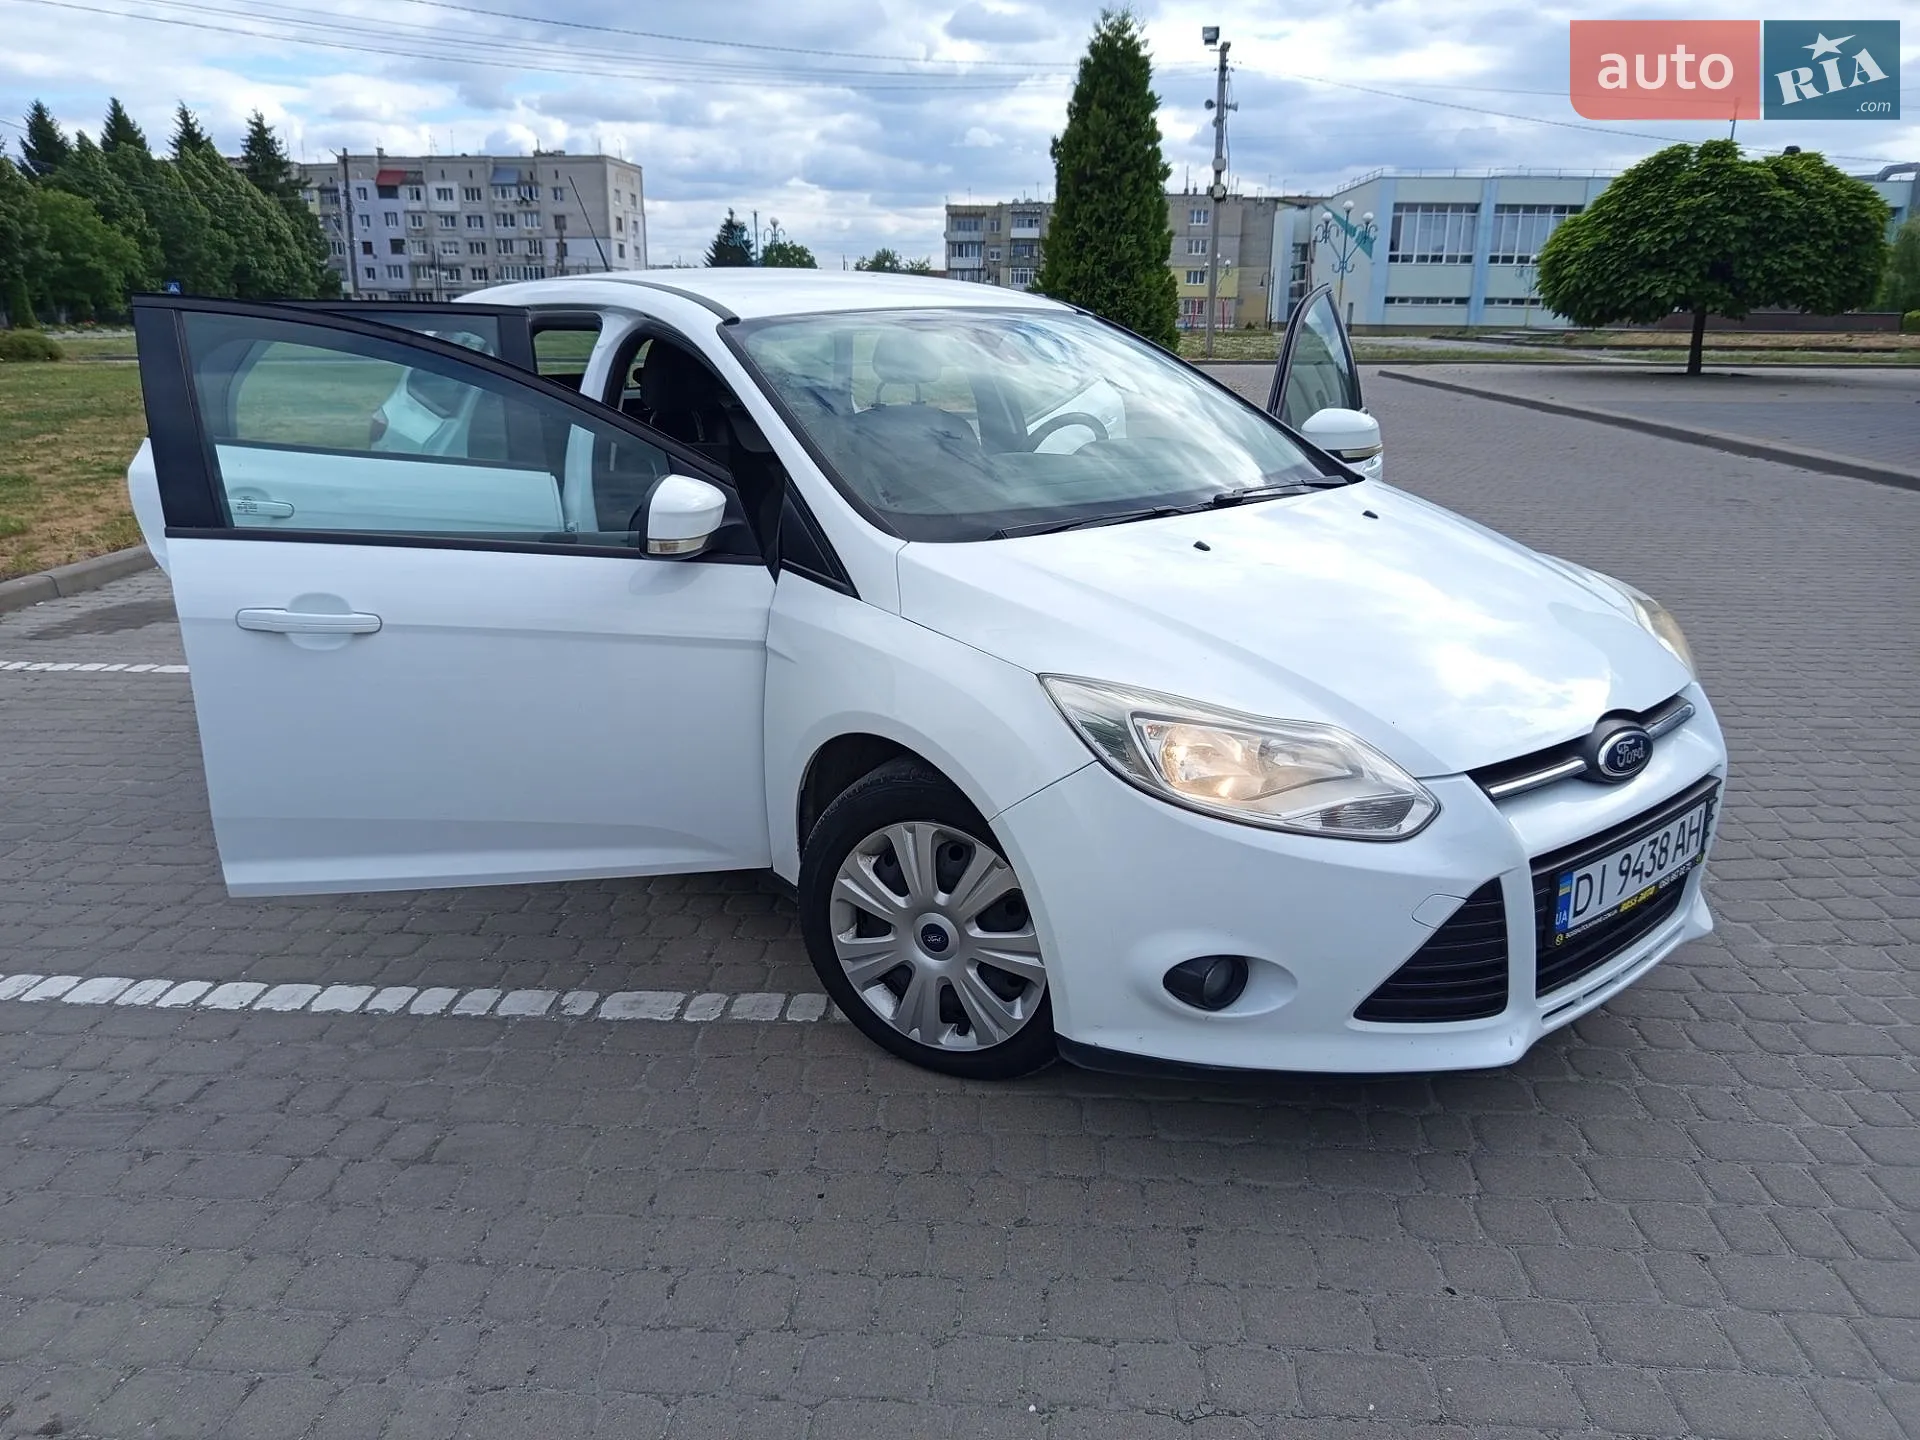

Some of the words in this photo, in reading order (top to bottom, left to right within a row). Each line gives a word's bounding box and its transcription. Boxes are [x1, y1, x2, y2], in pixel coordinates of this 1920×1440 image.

[1616, 739, 1644, 767] Ford
[1573, 873, 1606, 919] DI
[1617, 831, 1670, 896] 9438
[1672, 809, 1703, 863] AH
[1555, 910, 1568, 926] UA
